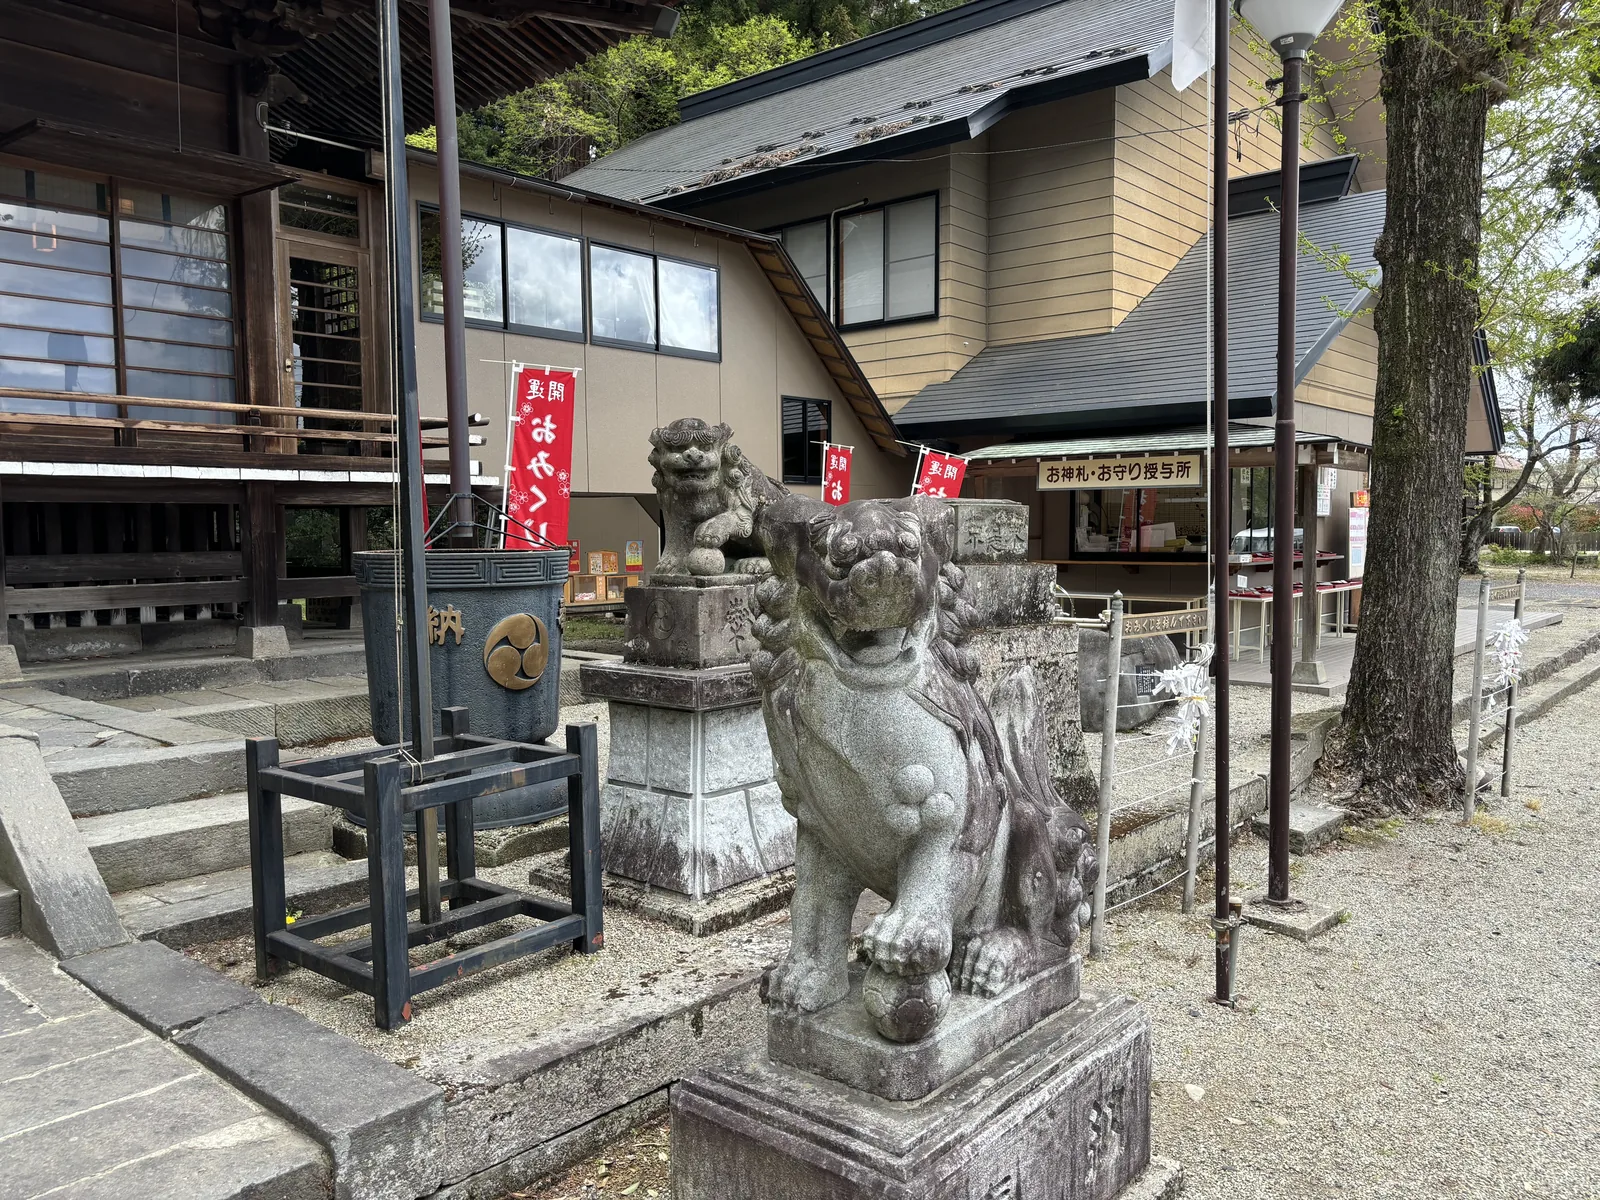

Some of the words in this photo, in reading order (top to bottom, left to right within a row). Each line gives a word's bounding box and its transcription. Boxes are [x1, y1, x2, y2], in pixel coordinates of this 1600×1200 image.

[1046, 461, 1192, 483] お神札・お守り授与所
[427, 603, 465, 646] 納
